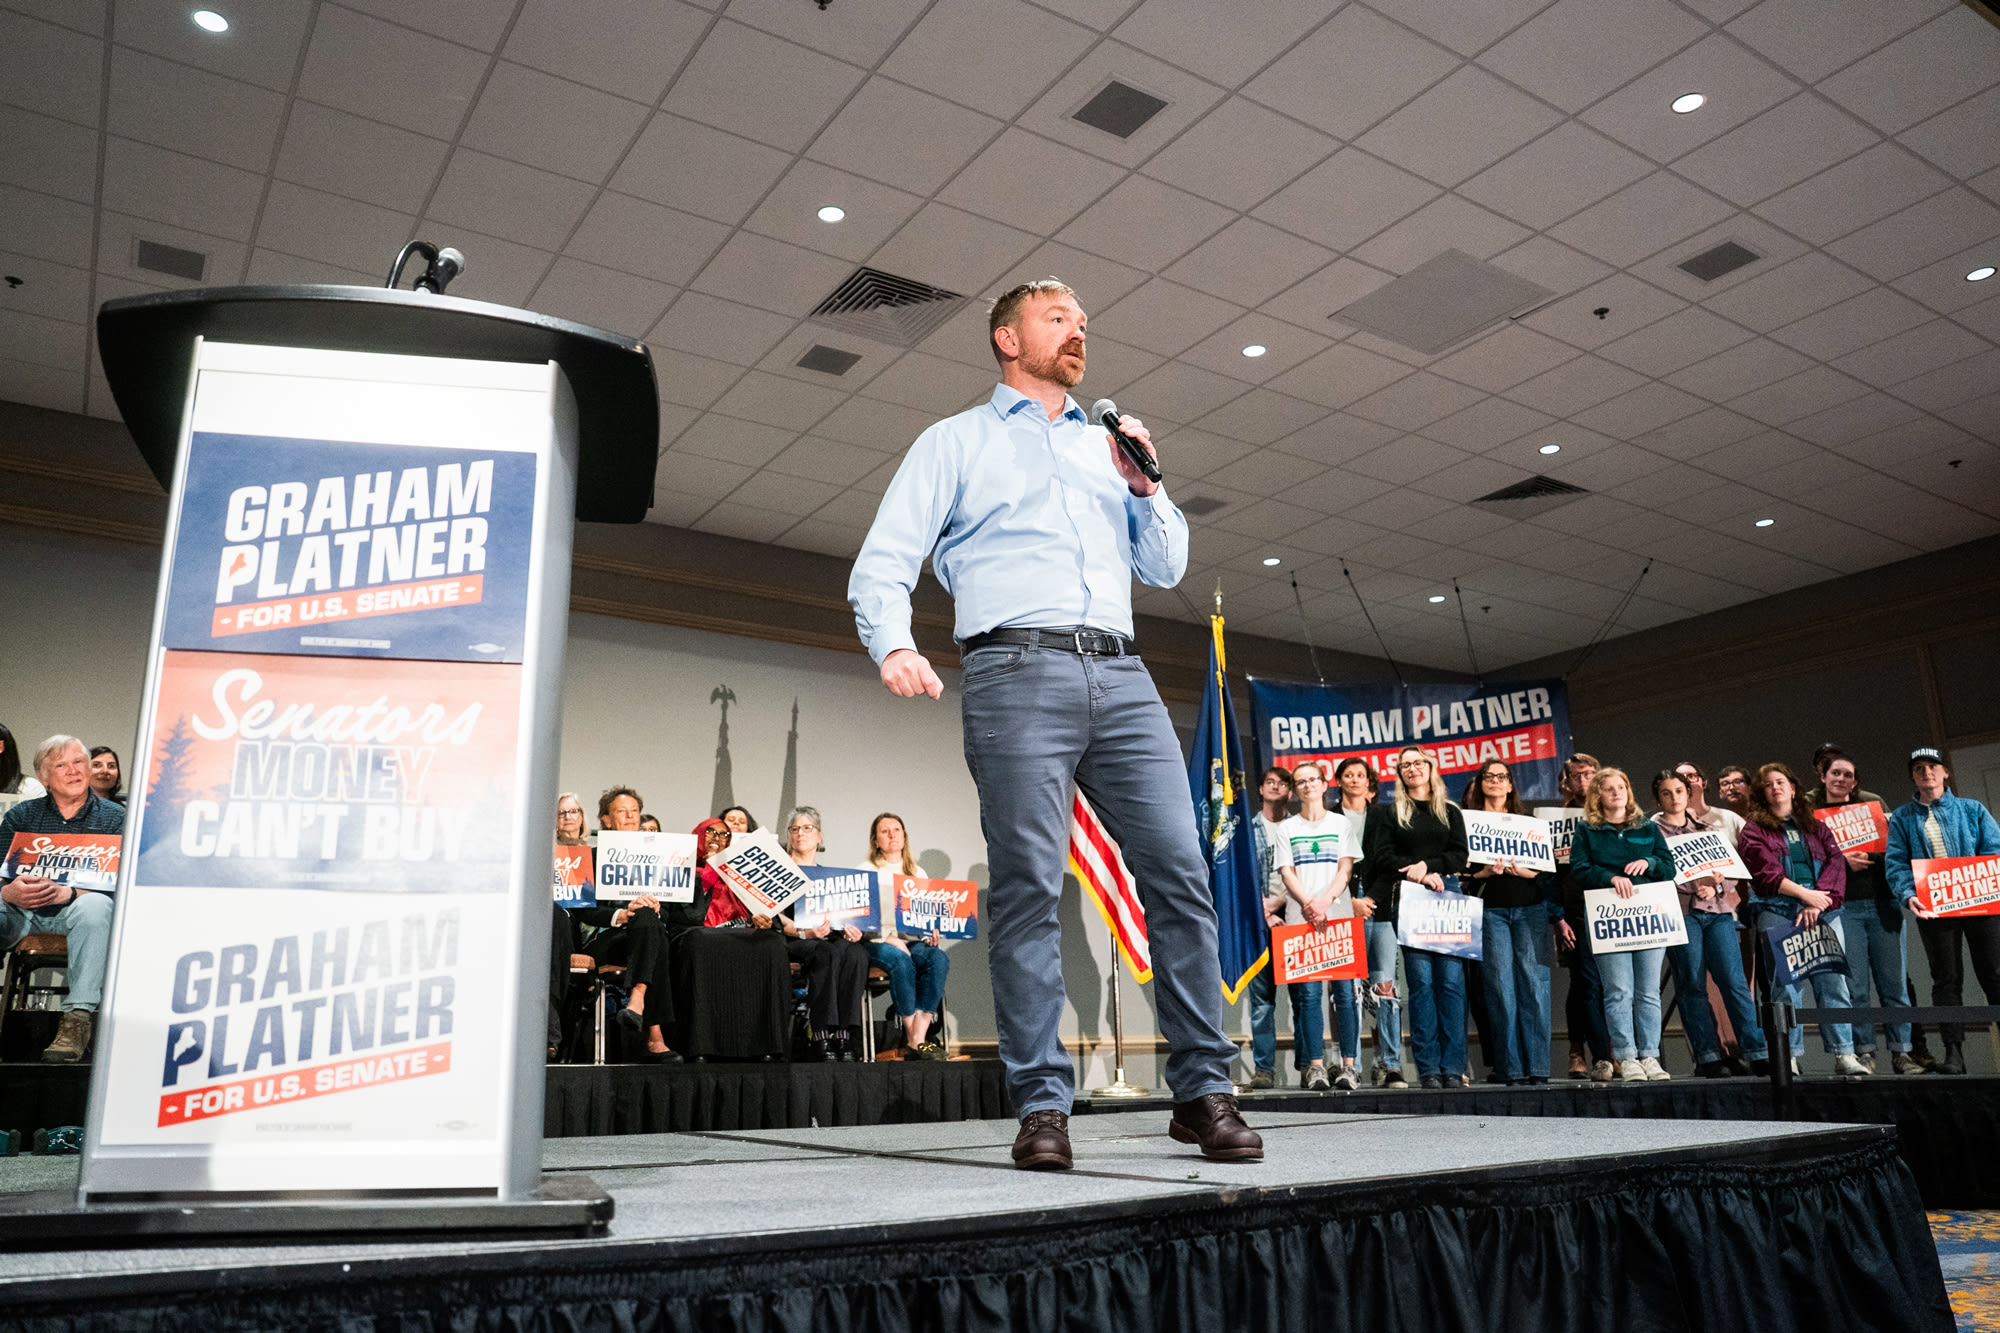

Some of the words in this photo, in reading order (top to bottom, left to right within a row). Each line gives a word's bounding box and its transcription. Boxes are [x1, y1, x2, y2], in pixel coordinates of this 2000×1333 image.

[224, 460, 494, 542] GRAHAM
[215, 517, 488, 603] PLATNER
[237, 603, 291, 629] FOR
[299, 597, 348, 621] U.S.
[356, 583, 460, 613] SENATE
[192, 668, 482, 744] Senators
[1270, 708, 1403, 750] GRAHAM
[1412, 688, 1552, 740] PLATNER
[230, 741, 434, 800] MONEY
[180, 800, 348, 859] CAN'T
[361, 805, 466, 860] BUY
[1472, 822, 1522, 838] Women
[1526, 830, 1544, 842] for
[607, 848, 664, 864] Women
[668, 850, 688, 865] for
[1469, 834, 1550, 860] GRAHAM
[1675, 846, 1730, 872] PLATNER
[36, 853, 112, 872] MONEY
[601, 864, 691, 888] GRAHAM
[744, 846, 806, 892] GRAHAM
[553, 885, 583, 900] BUY
[727, 855, 790, 903] PLATNER
[900, 879, 968, 903] Senators
[1930, 876, 2000, 906] PLATNE
[806, 890, 870, 915] PLATNER
[911, 899, 958, 918] MONEY
[1596, 904, 1652, 918] Women
[1940, 904, 1955, 912] FOR
[902, 911, 937, 930] CAN'T
[940, 918, 968, 932] BUY
[1594, 912, 1681, 940] GRAHAM
[1284, 920, 1352, 955] GRAHAM
[171, 907, 461, 1015] GRAHAM
[1285, 938, 1354, 971] PLATNER
[1292, 969, 1306, 977] FOR
[1322, 958, 1348, 968] SENATE
[1786, 940, 1843, 972] PLATNE
[162, 975, 455, 1087] PLATNER
[184, 1086, 244, 1118] FOR
[254, 1074, 306, 1101] U.S.
[315, 1050, 427, 1092] SENATE
